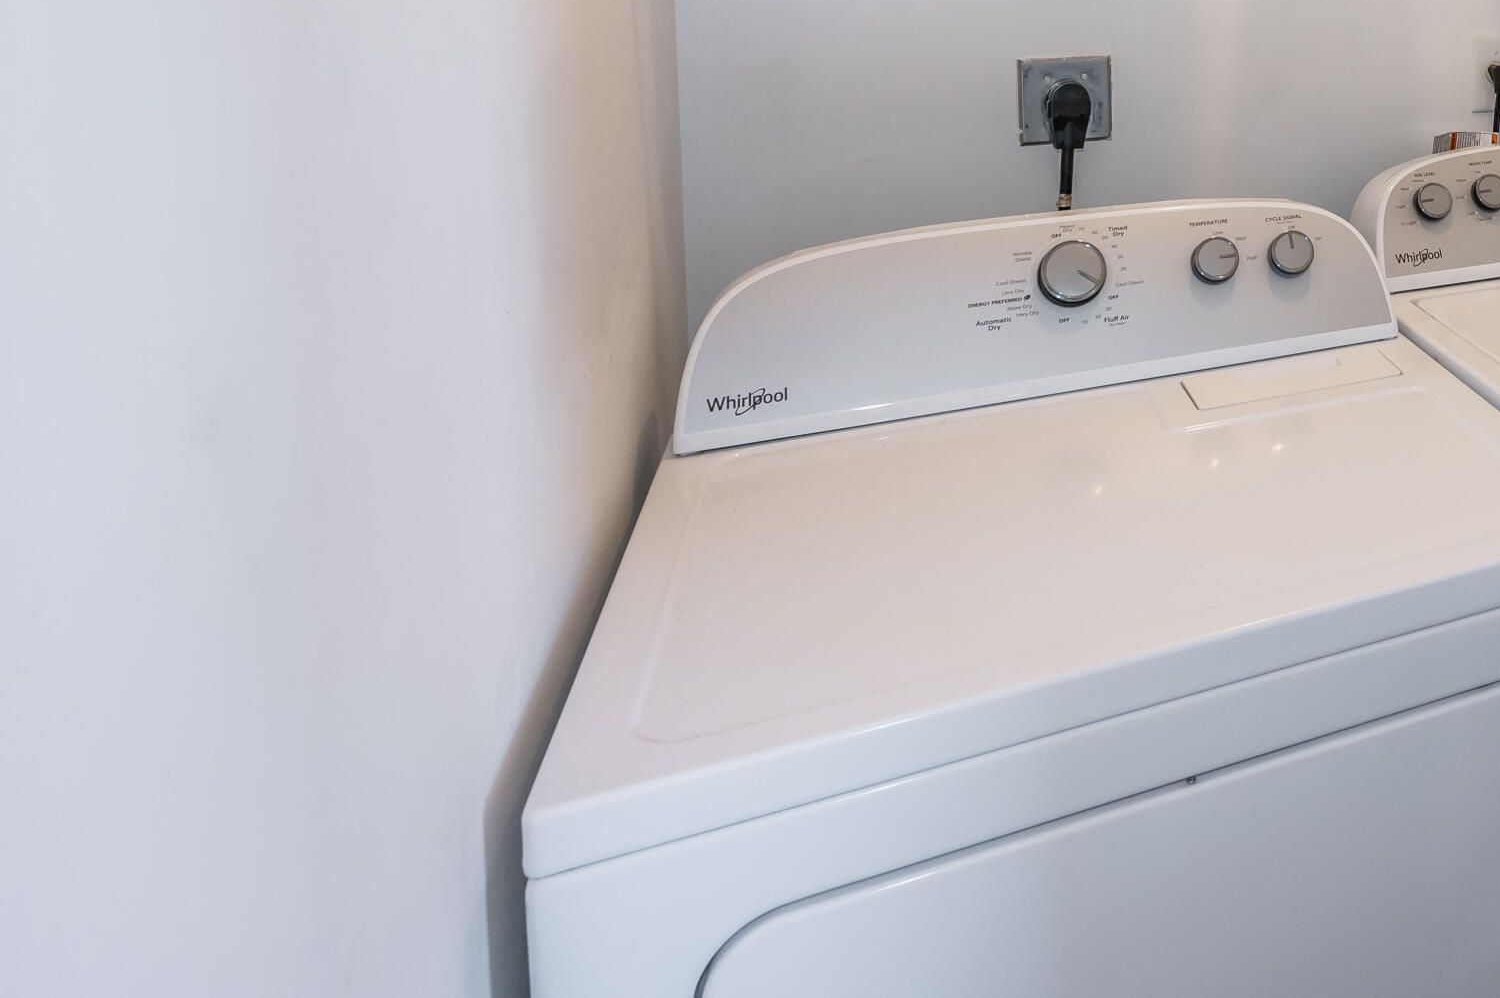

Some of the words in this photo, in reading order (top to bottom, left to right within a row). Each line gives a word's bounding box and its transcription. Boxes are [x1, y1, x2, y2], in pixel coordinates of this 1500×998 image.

[1189, 218, 1228, 227] TEMPERATURE
[1394, 248, 1443, 268] Whirlpool
[968, 301, 991, 309] ENERGY
[976, 317, 1013, 327] Automatic
[1104, 315, 1119, 323] Fluff
[706, 386, 788, 416] Whirlpool
